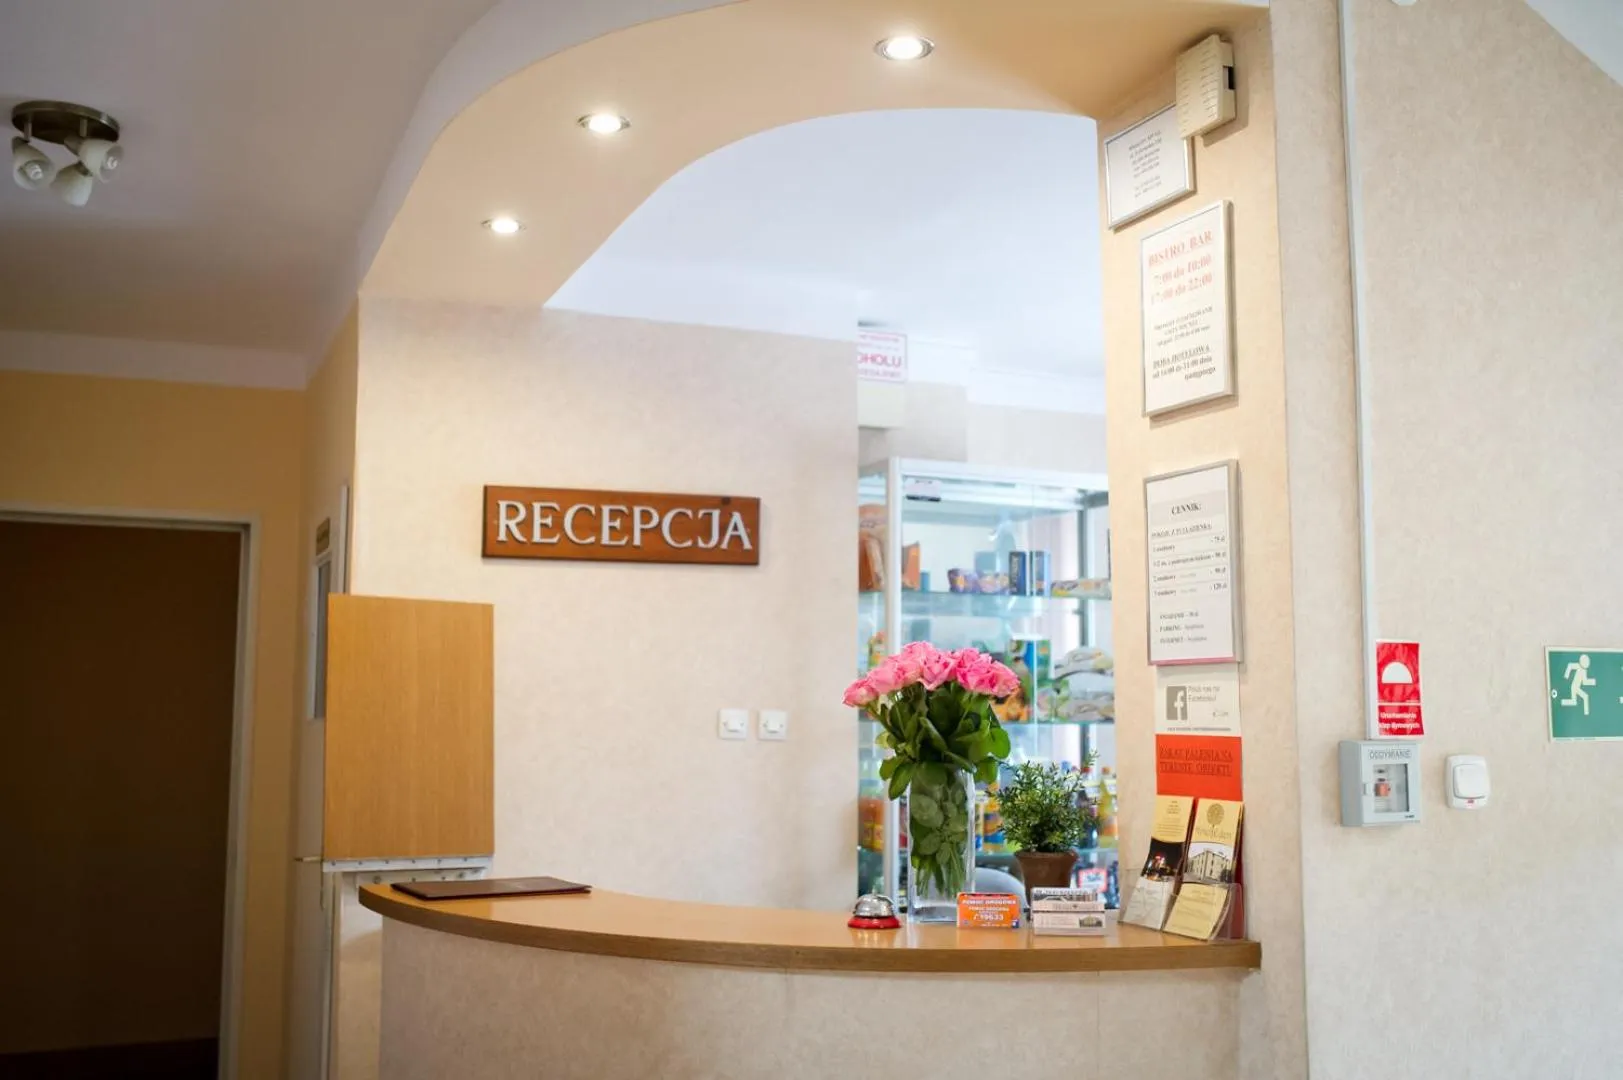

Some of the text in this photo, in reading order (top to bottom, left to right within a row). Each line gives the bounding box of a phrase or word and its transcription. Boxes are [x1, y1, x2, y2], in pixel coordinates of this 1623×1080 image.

[1148, 231, 1212, 267] BISTRO BAR
[496, 499, 753, 550] RECEPCJA
